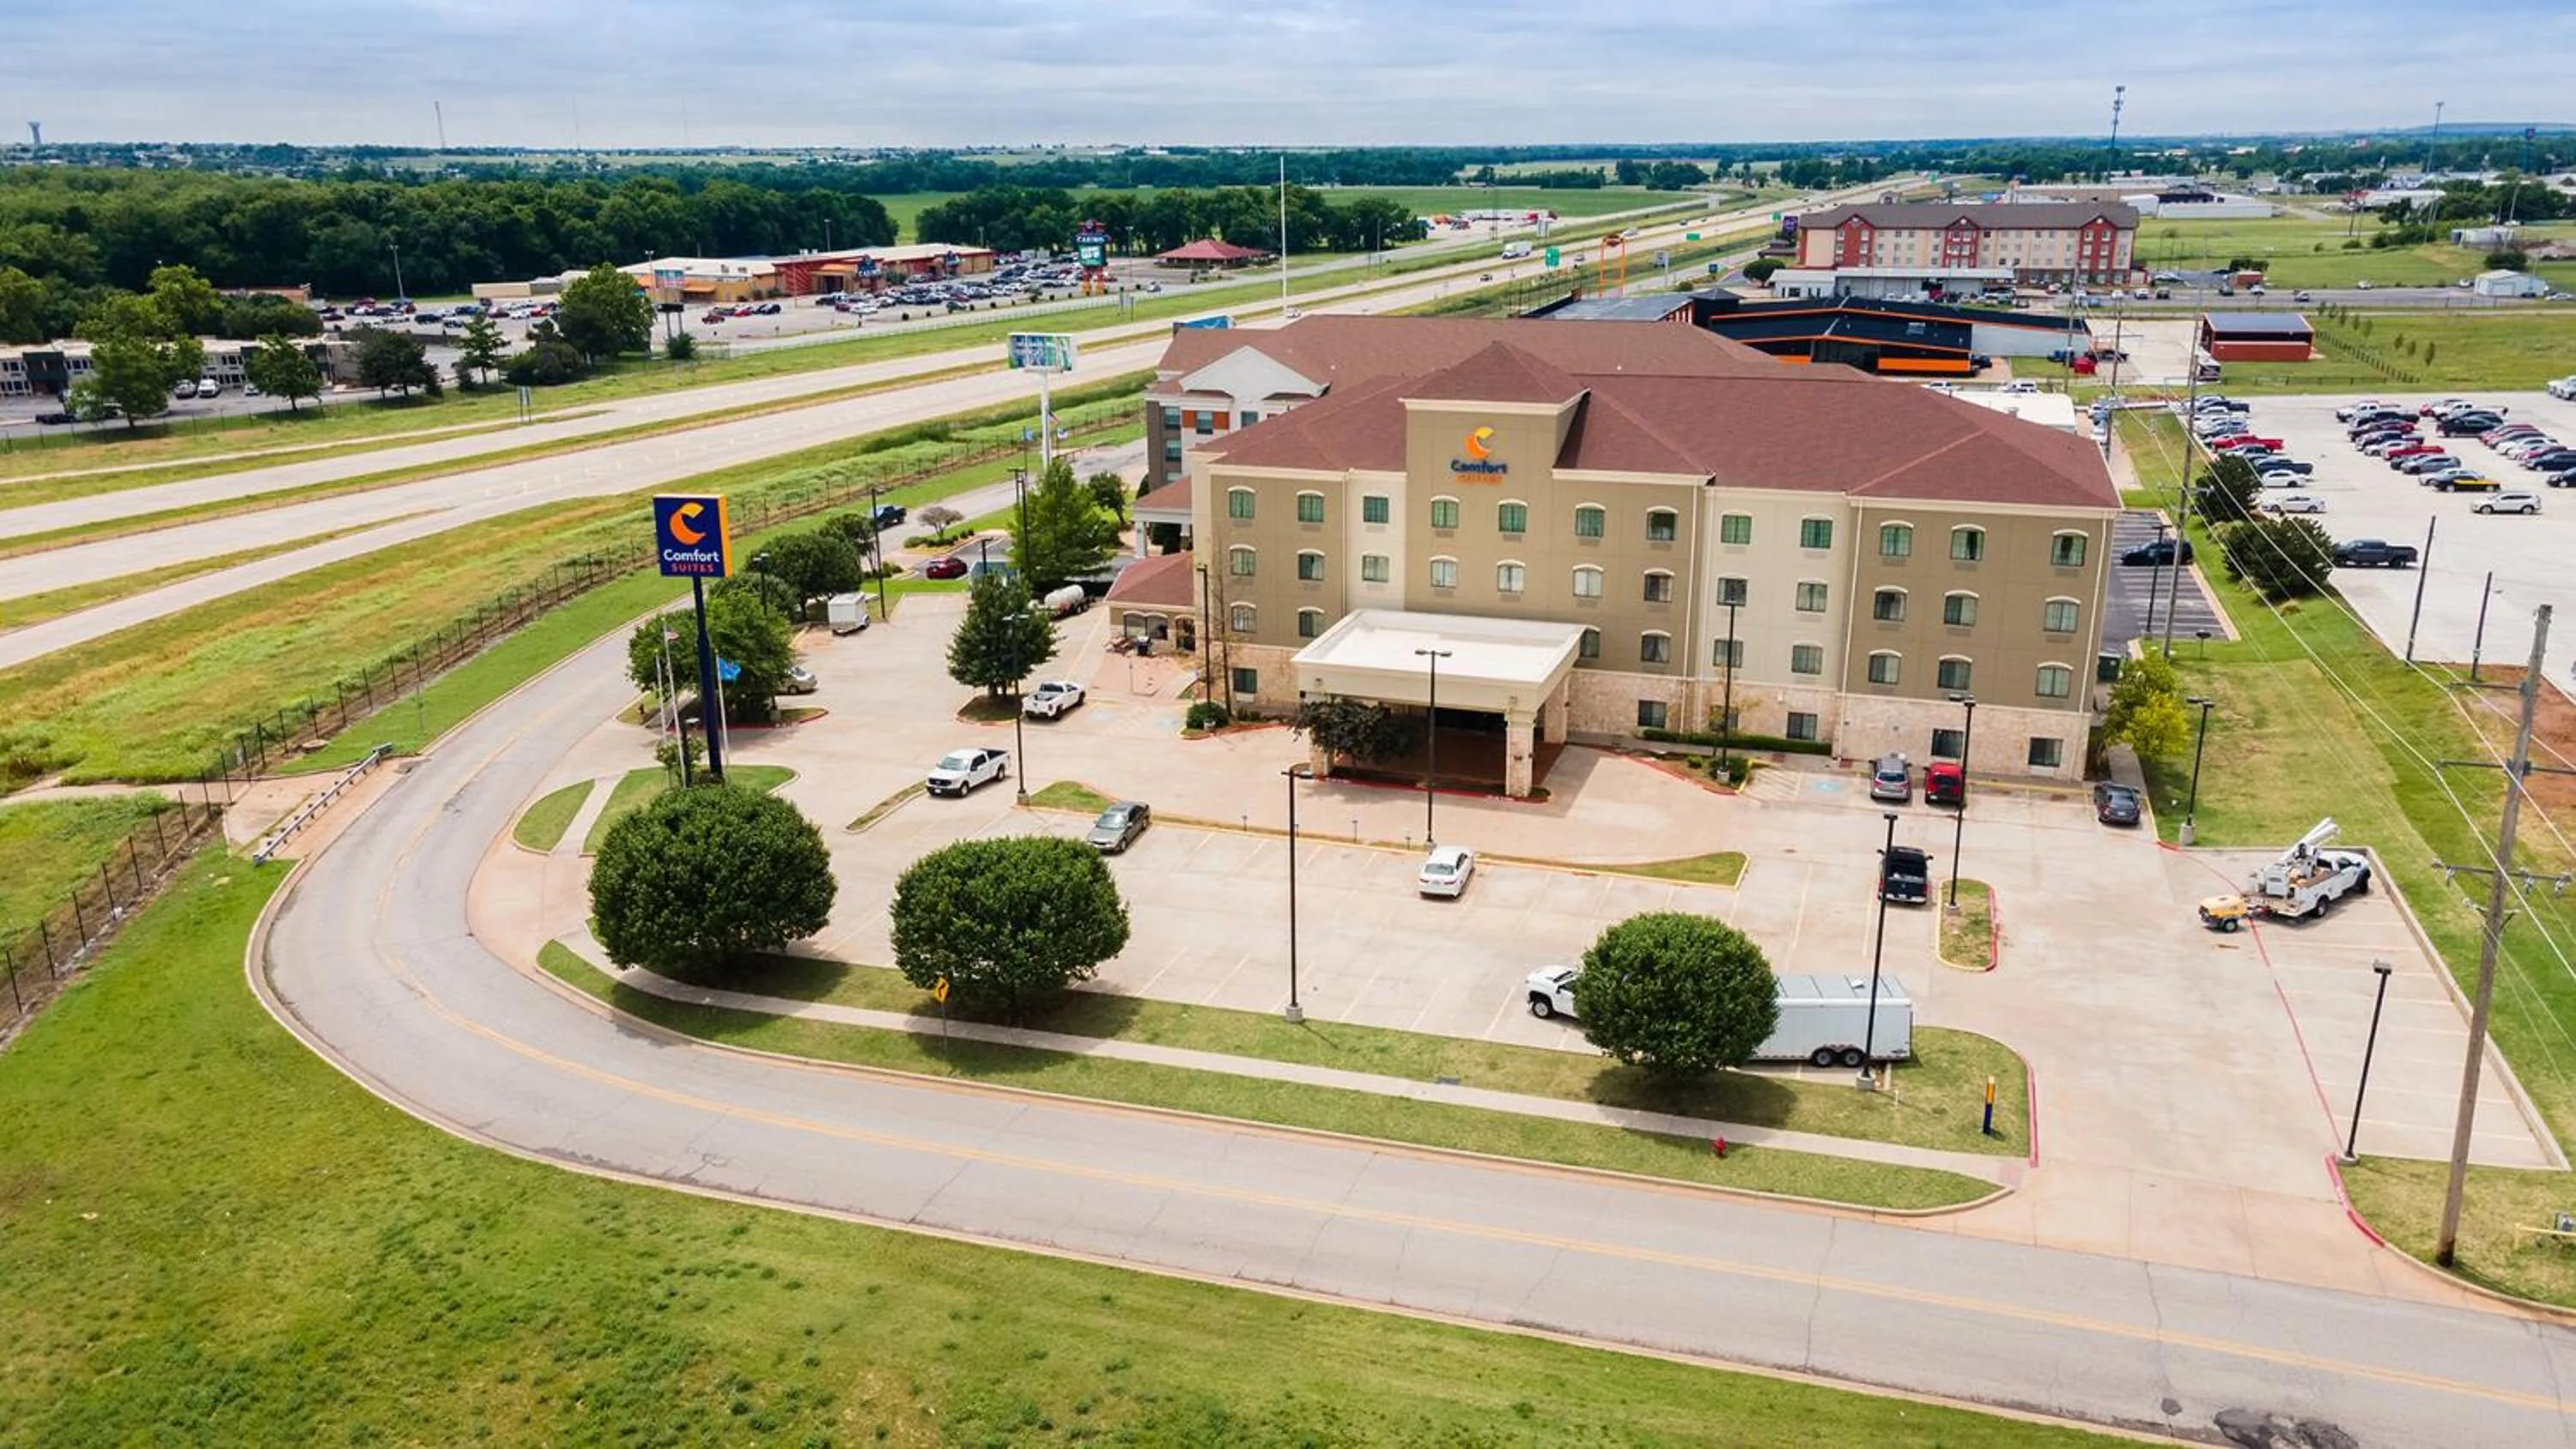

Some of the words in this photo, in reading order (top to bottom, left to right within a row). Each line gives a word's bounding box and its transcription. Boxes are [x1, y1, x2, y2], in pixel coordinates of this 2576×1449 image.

[1450, 459, 1507, 474] Comfort
[663, 549, 720, 562] Comfort
[671, 563, 714, 573] SUITES
